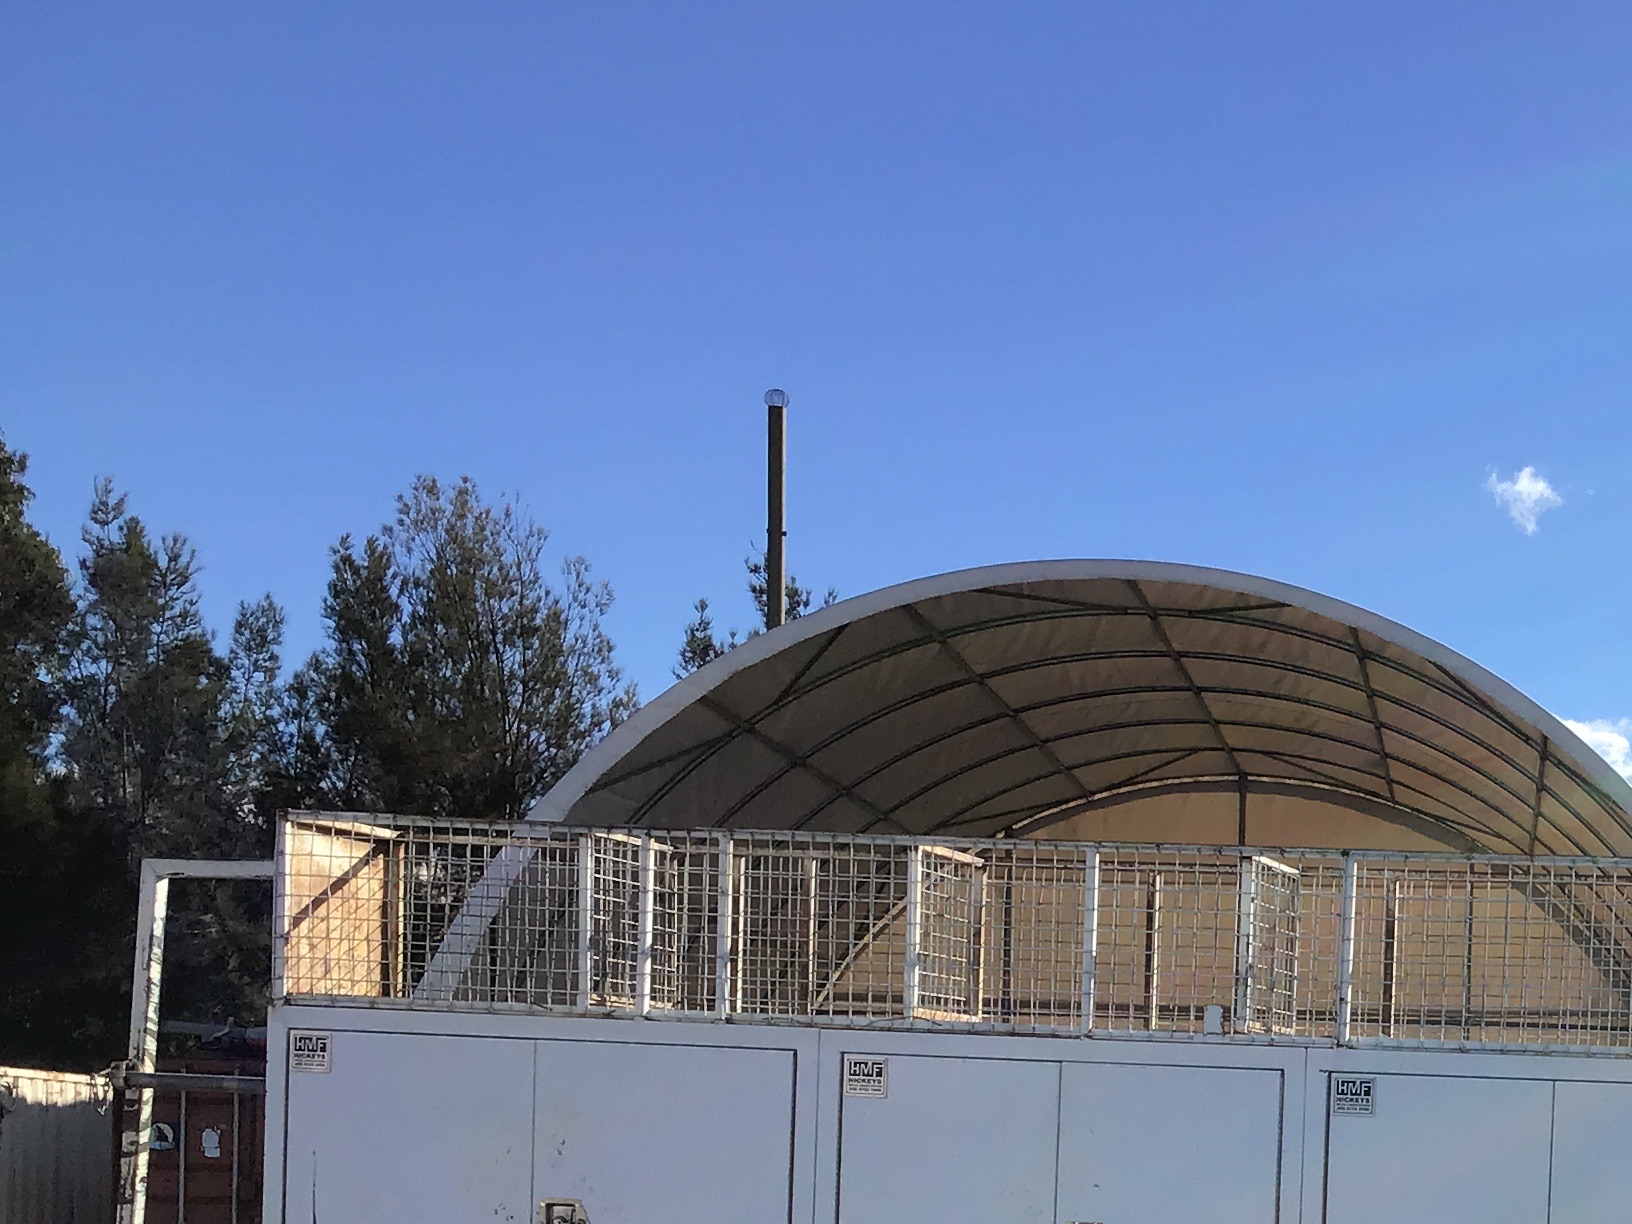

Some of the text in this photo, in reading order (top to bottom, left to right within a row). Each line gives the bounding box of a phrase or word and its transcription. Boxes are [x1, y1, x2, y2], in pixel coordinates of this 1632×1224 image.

[294, 1037, 327, 1052] HMF
[849, 1061, 883, 1077] HMF
[1336, 1080, 1371, 1096] HMF
